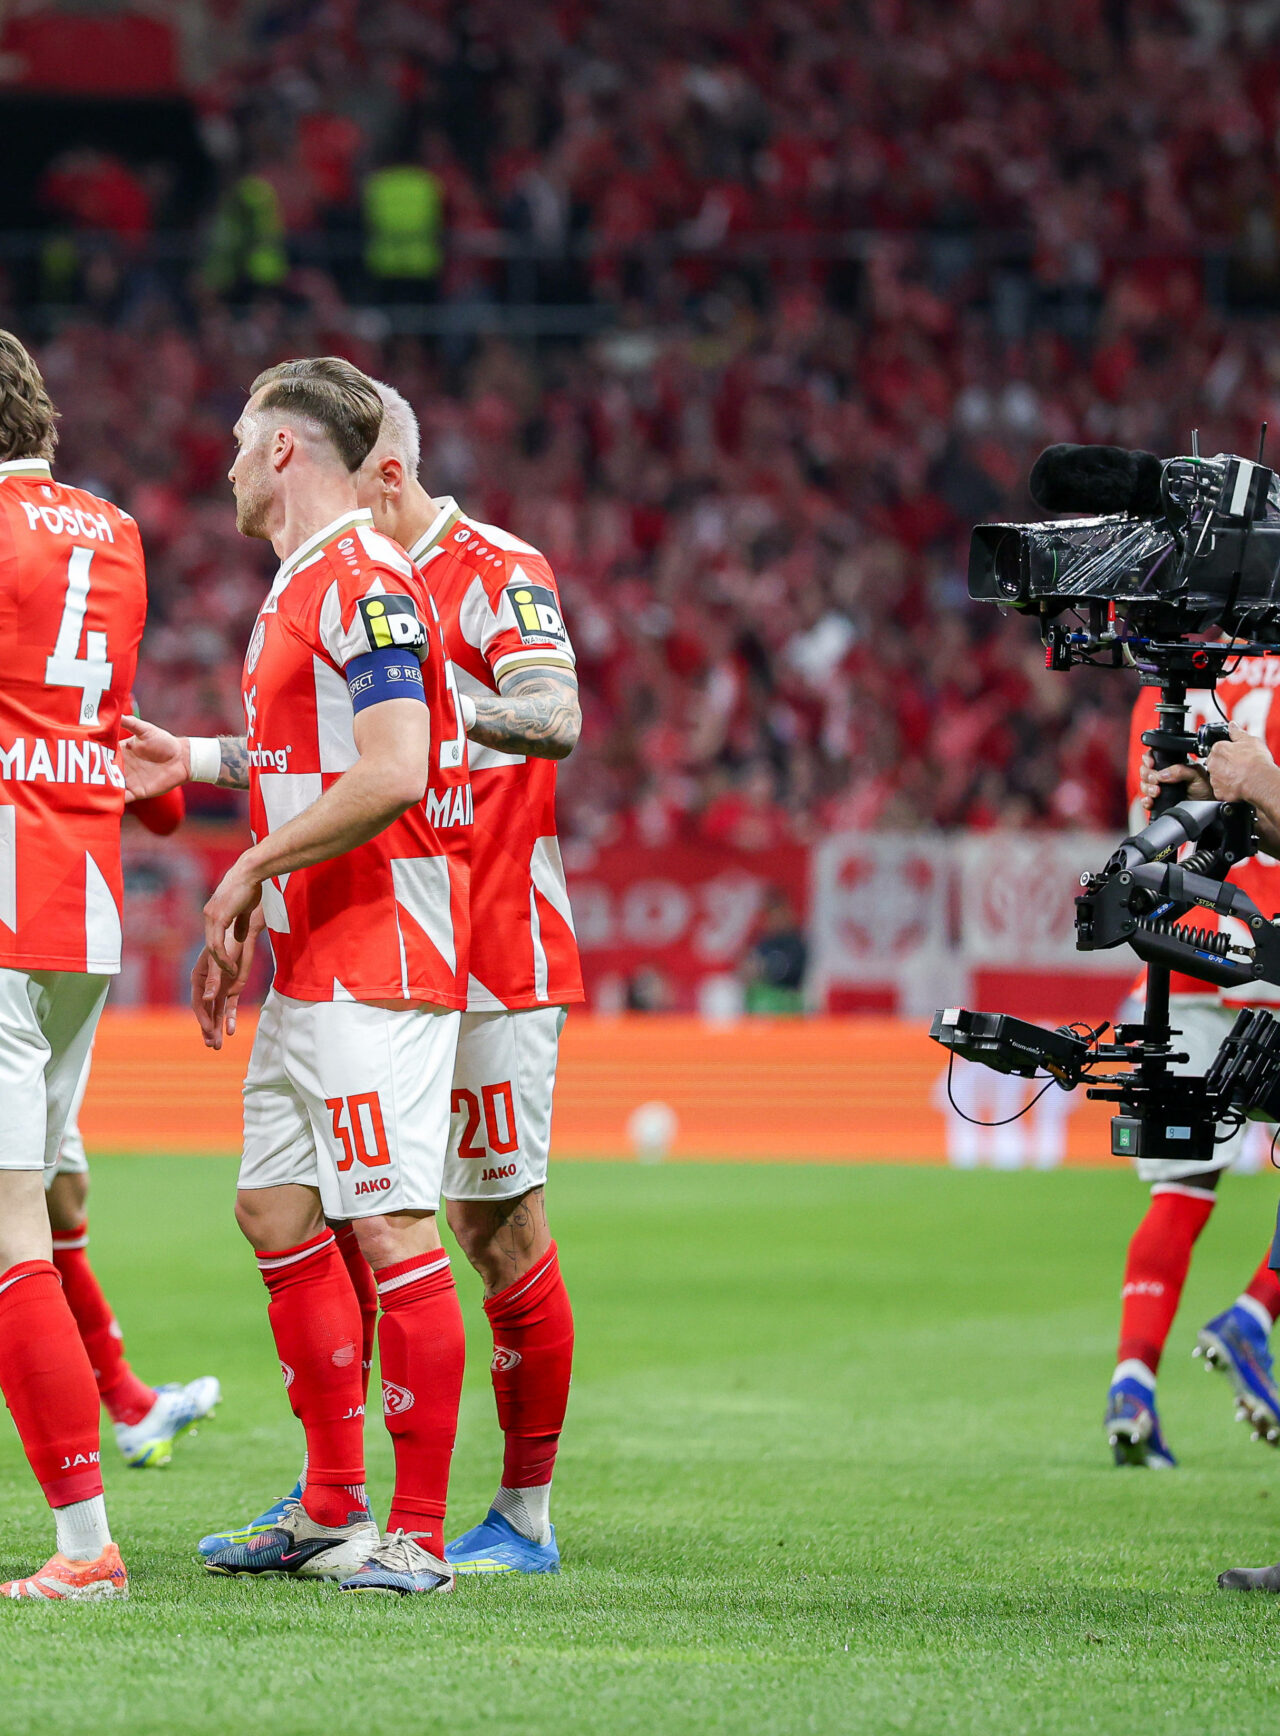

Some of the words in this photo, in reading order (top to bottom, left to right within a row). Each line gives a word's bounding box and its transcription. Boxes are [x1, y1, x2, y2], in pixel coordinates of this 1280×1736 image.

[20, 501, 114, 543] POSCH
[45, 545, 114, 726] 4
[324, 1090, 391, 1172] 30
[451, 1080, 519, 1160] 20
[354, 1177, 391, 1196] JAKO
[482, 1163, 517, 1181] JAKO
